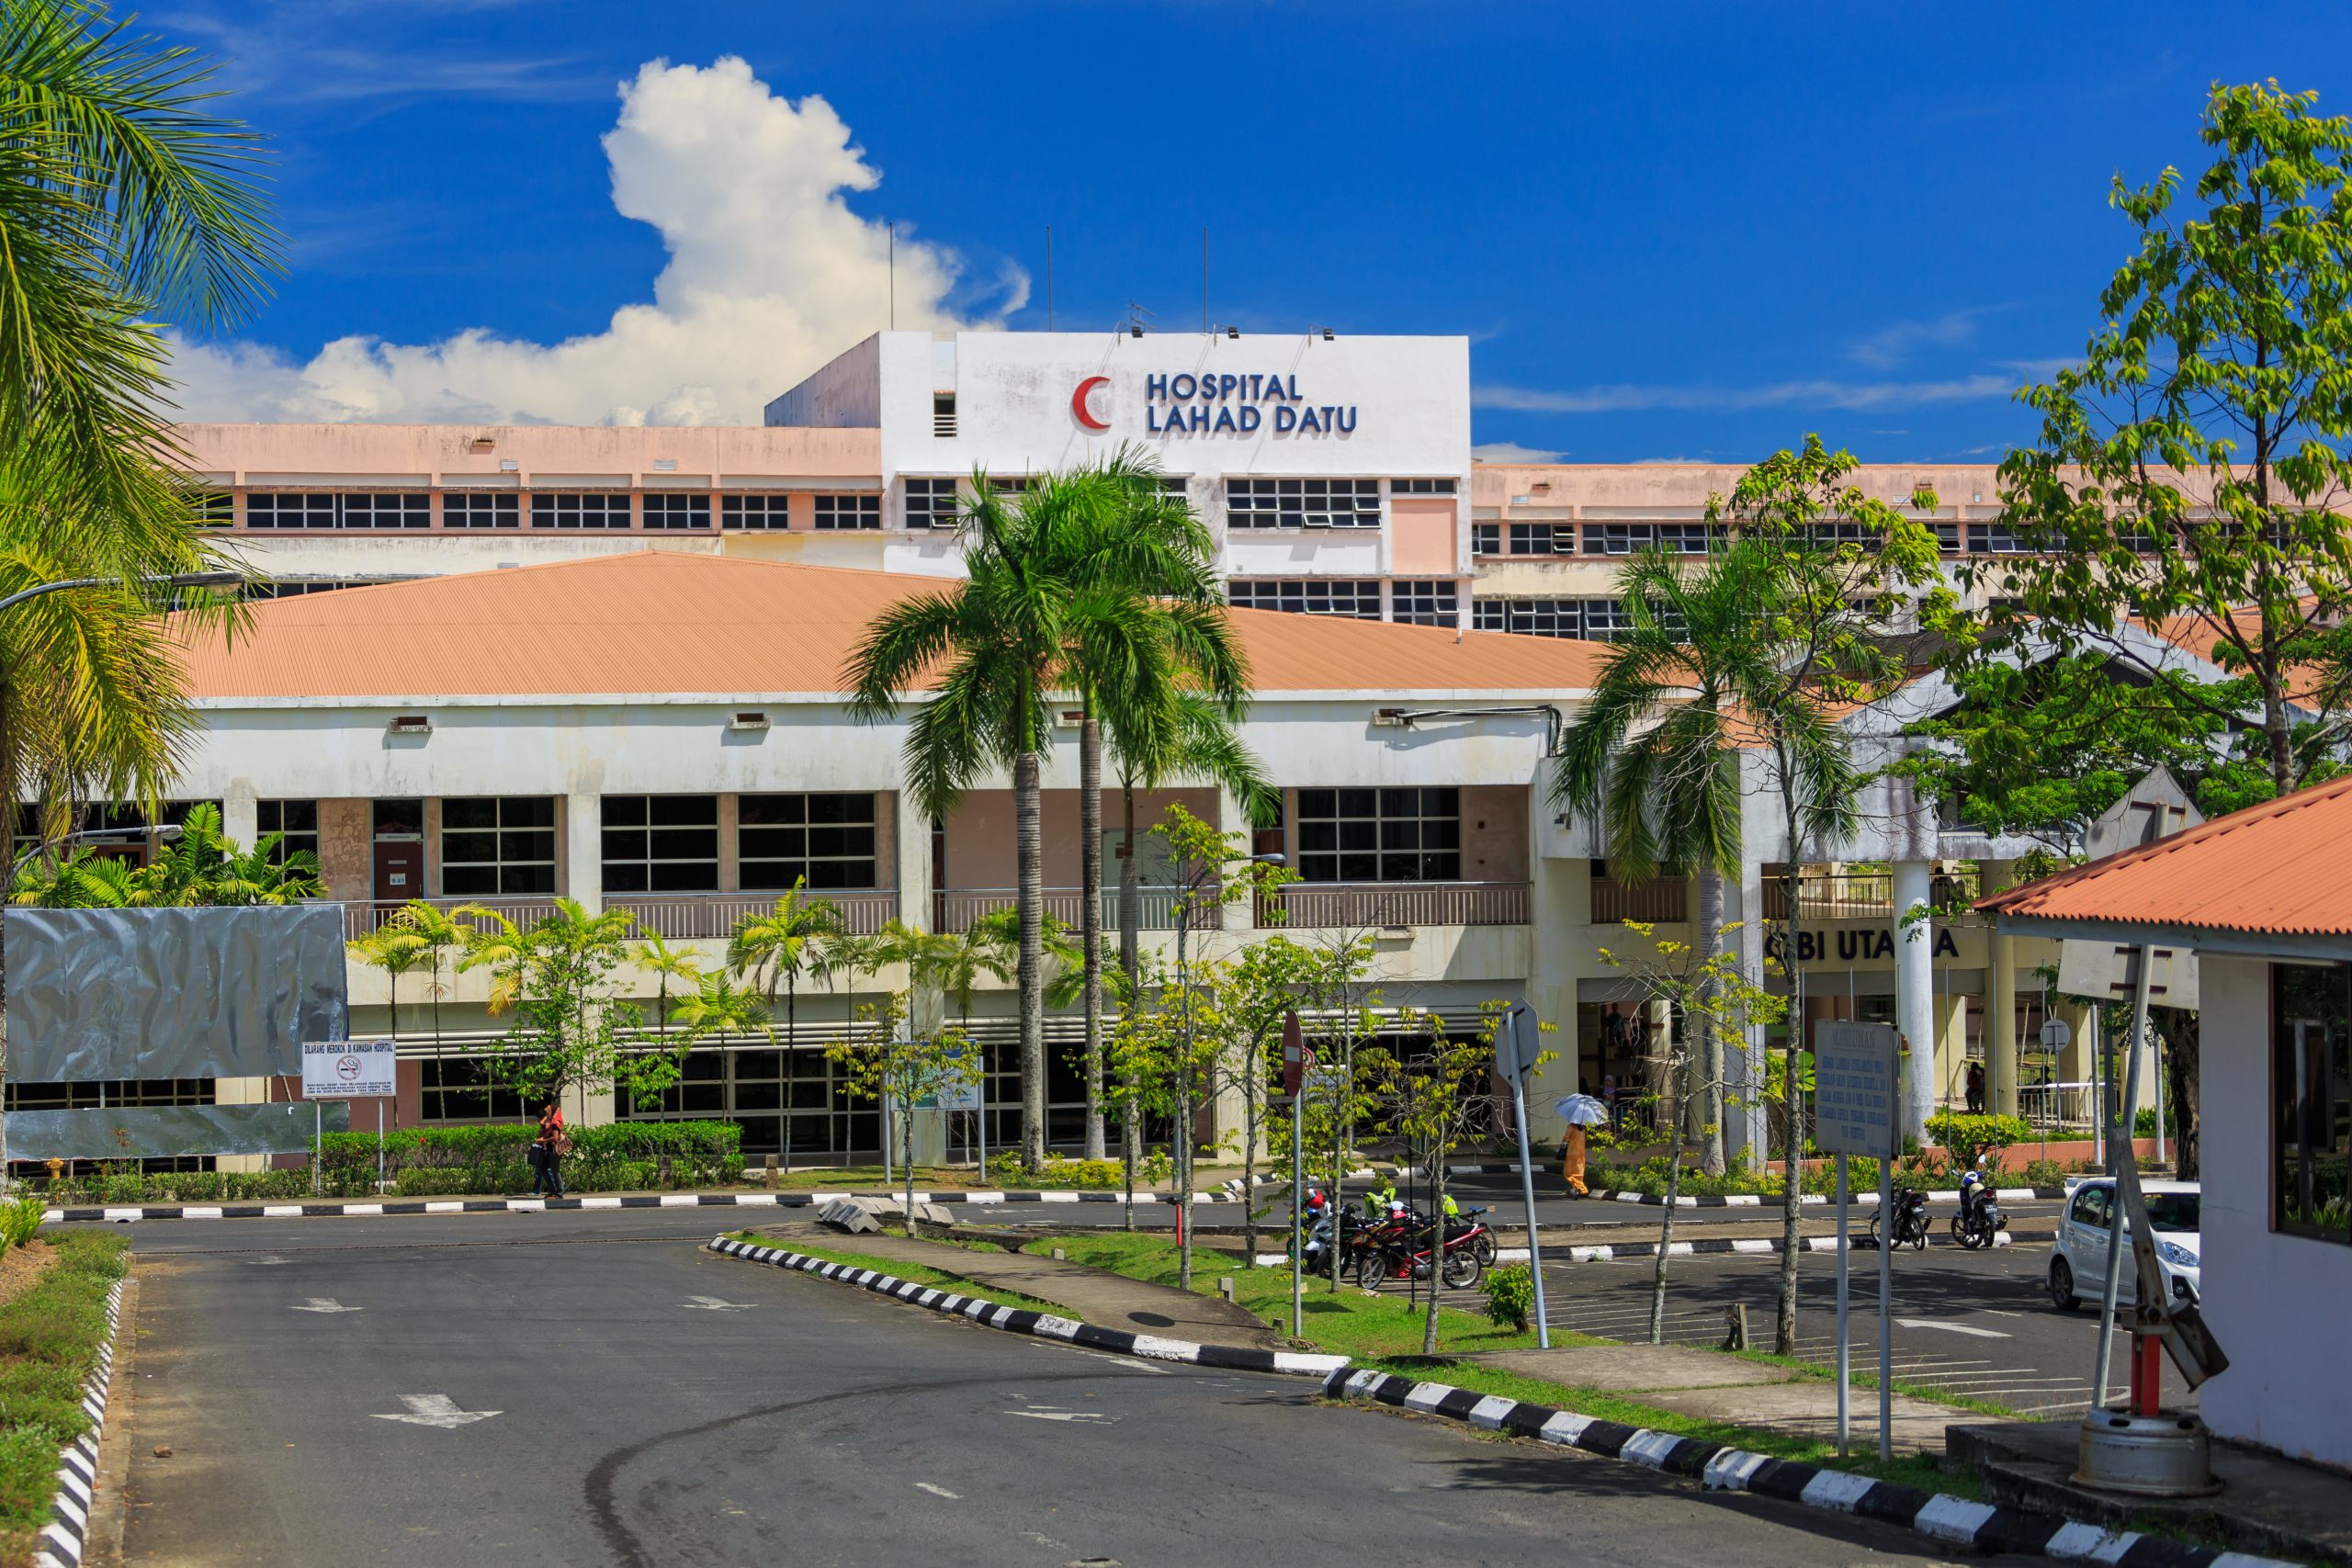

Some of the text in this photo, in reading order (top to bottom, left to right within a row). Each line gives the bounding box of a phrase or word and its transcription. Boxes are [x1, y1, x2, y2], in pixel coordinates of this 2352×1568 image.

[1148, 374, 1303, 400] HOSPITAL
[1148, 406, 1357, 433] LAHAD DATU
[1765, 929, 1959, 961] OBI UTAA
[304, 1043, 392, 1055] DILARANG MEROKOK DI KAWASAN HOSPITAL
